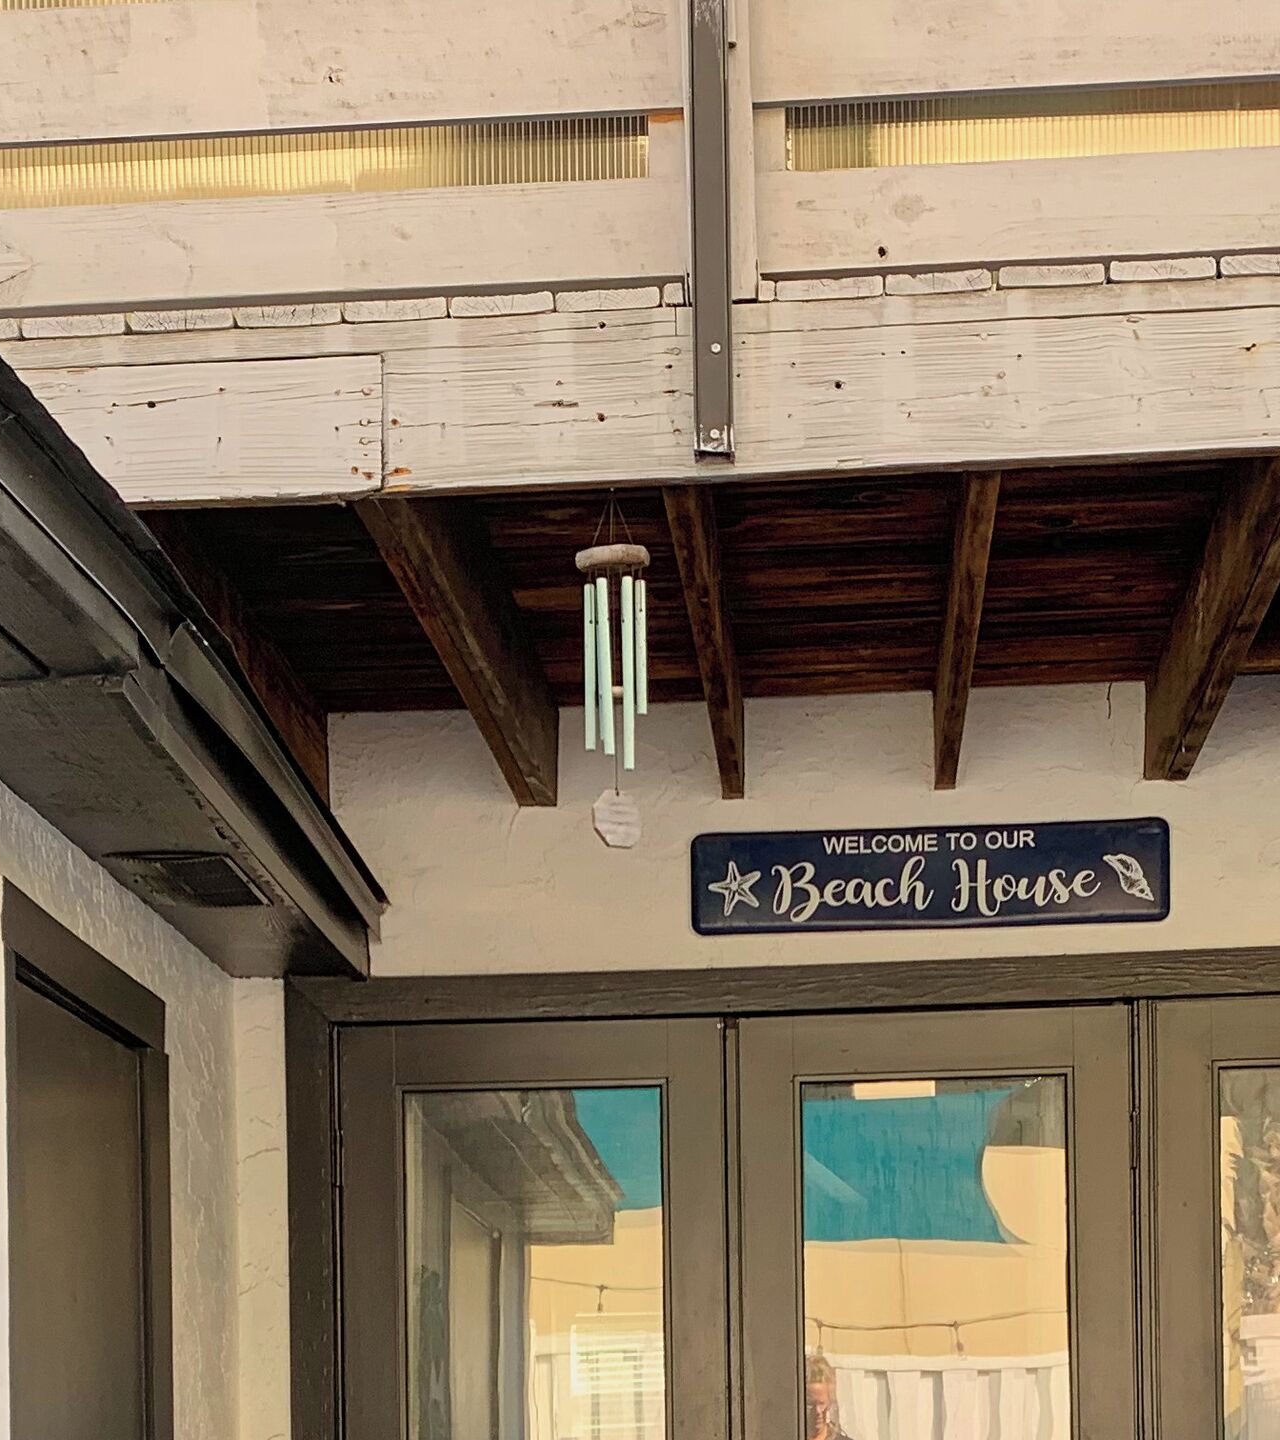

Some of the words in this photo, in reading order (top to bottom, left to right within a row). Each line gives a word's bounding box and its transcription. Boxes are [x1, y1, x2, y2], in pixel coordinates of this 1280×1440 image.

[822, 832, 938, 855] WELCOME
[946, 831, 977, 852] TO
[984, 829, 1036, 850] OUR
[771, 855, 935, 923] Beach
[951, 857, 1102, 917] House
